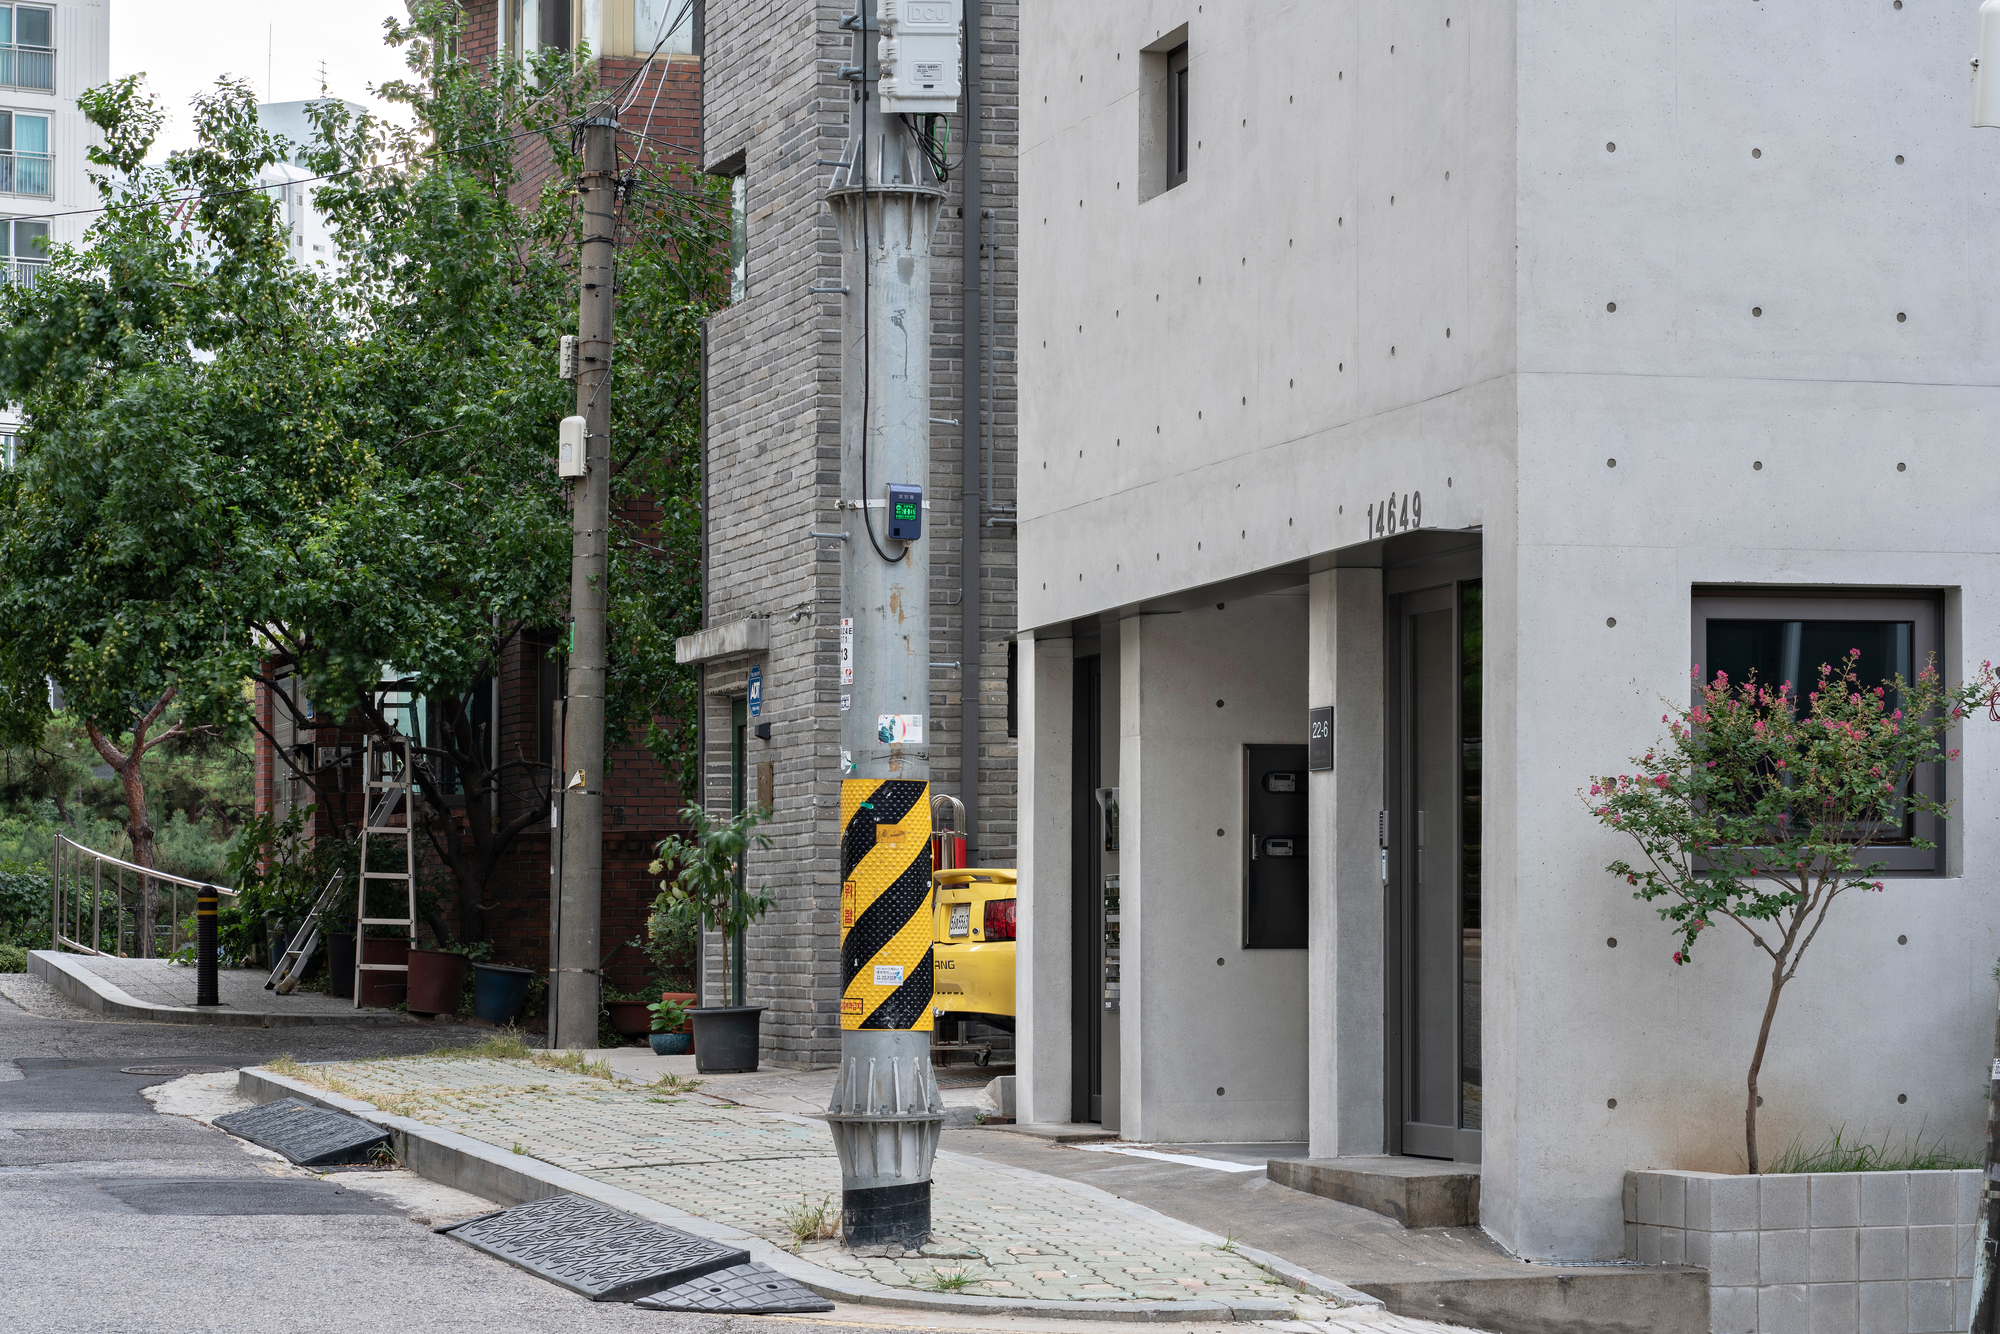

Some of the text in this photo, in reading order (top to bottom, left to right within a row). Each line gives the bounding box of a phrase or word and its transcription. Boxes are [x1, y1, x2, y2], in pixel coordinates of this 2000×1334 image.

[912, 6, 945, 21] DCU
[1367, 490, 1421, 539] 14649
[750, 681, 761, 700] ADT
[1312, 720, 1328, 738] 22-6
[844, 884, 853, 924] 위험
